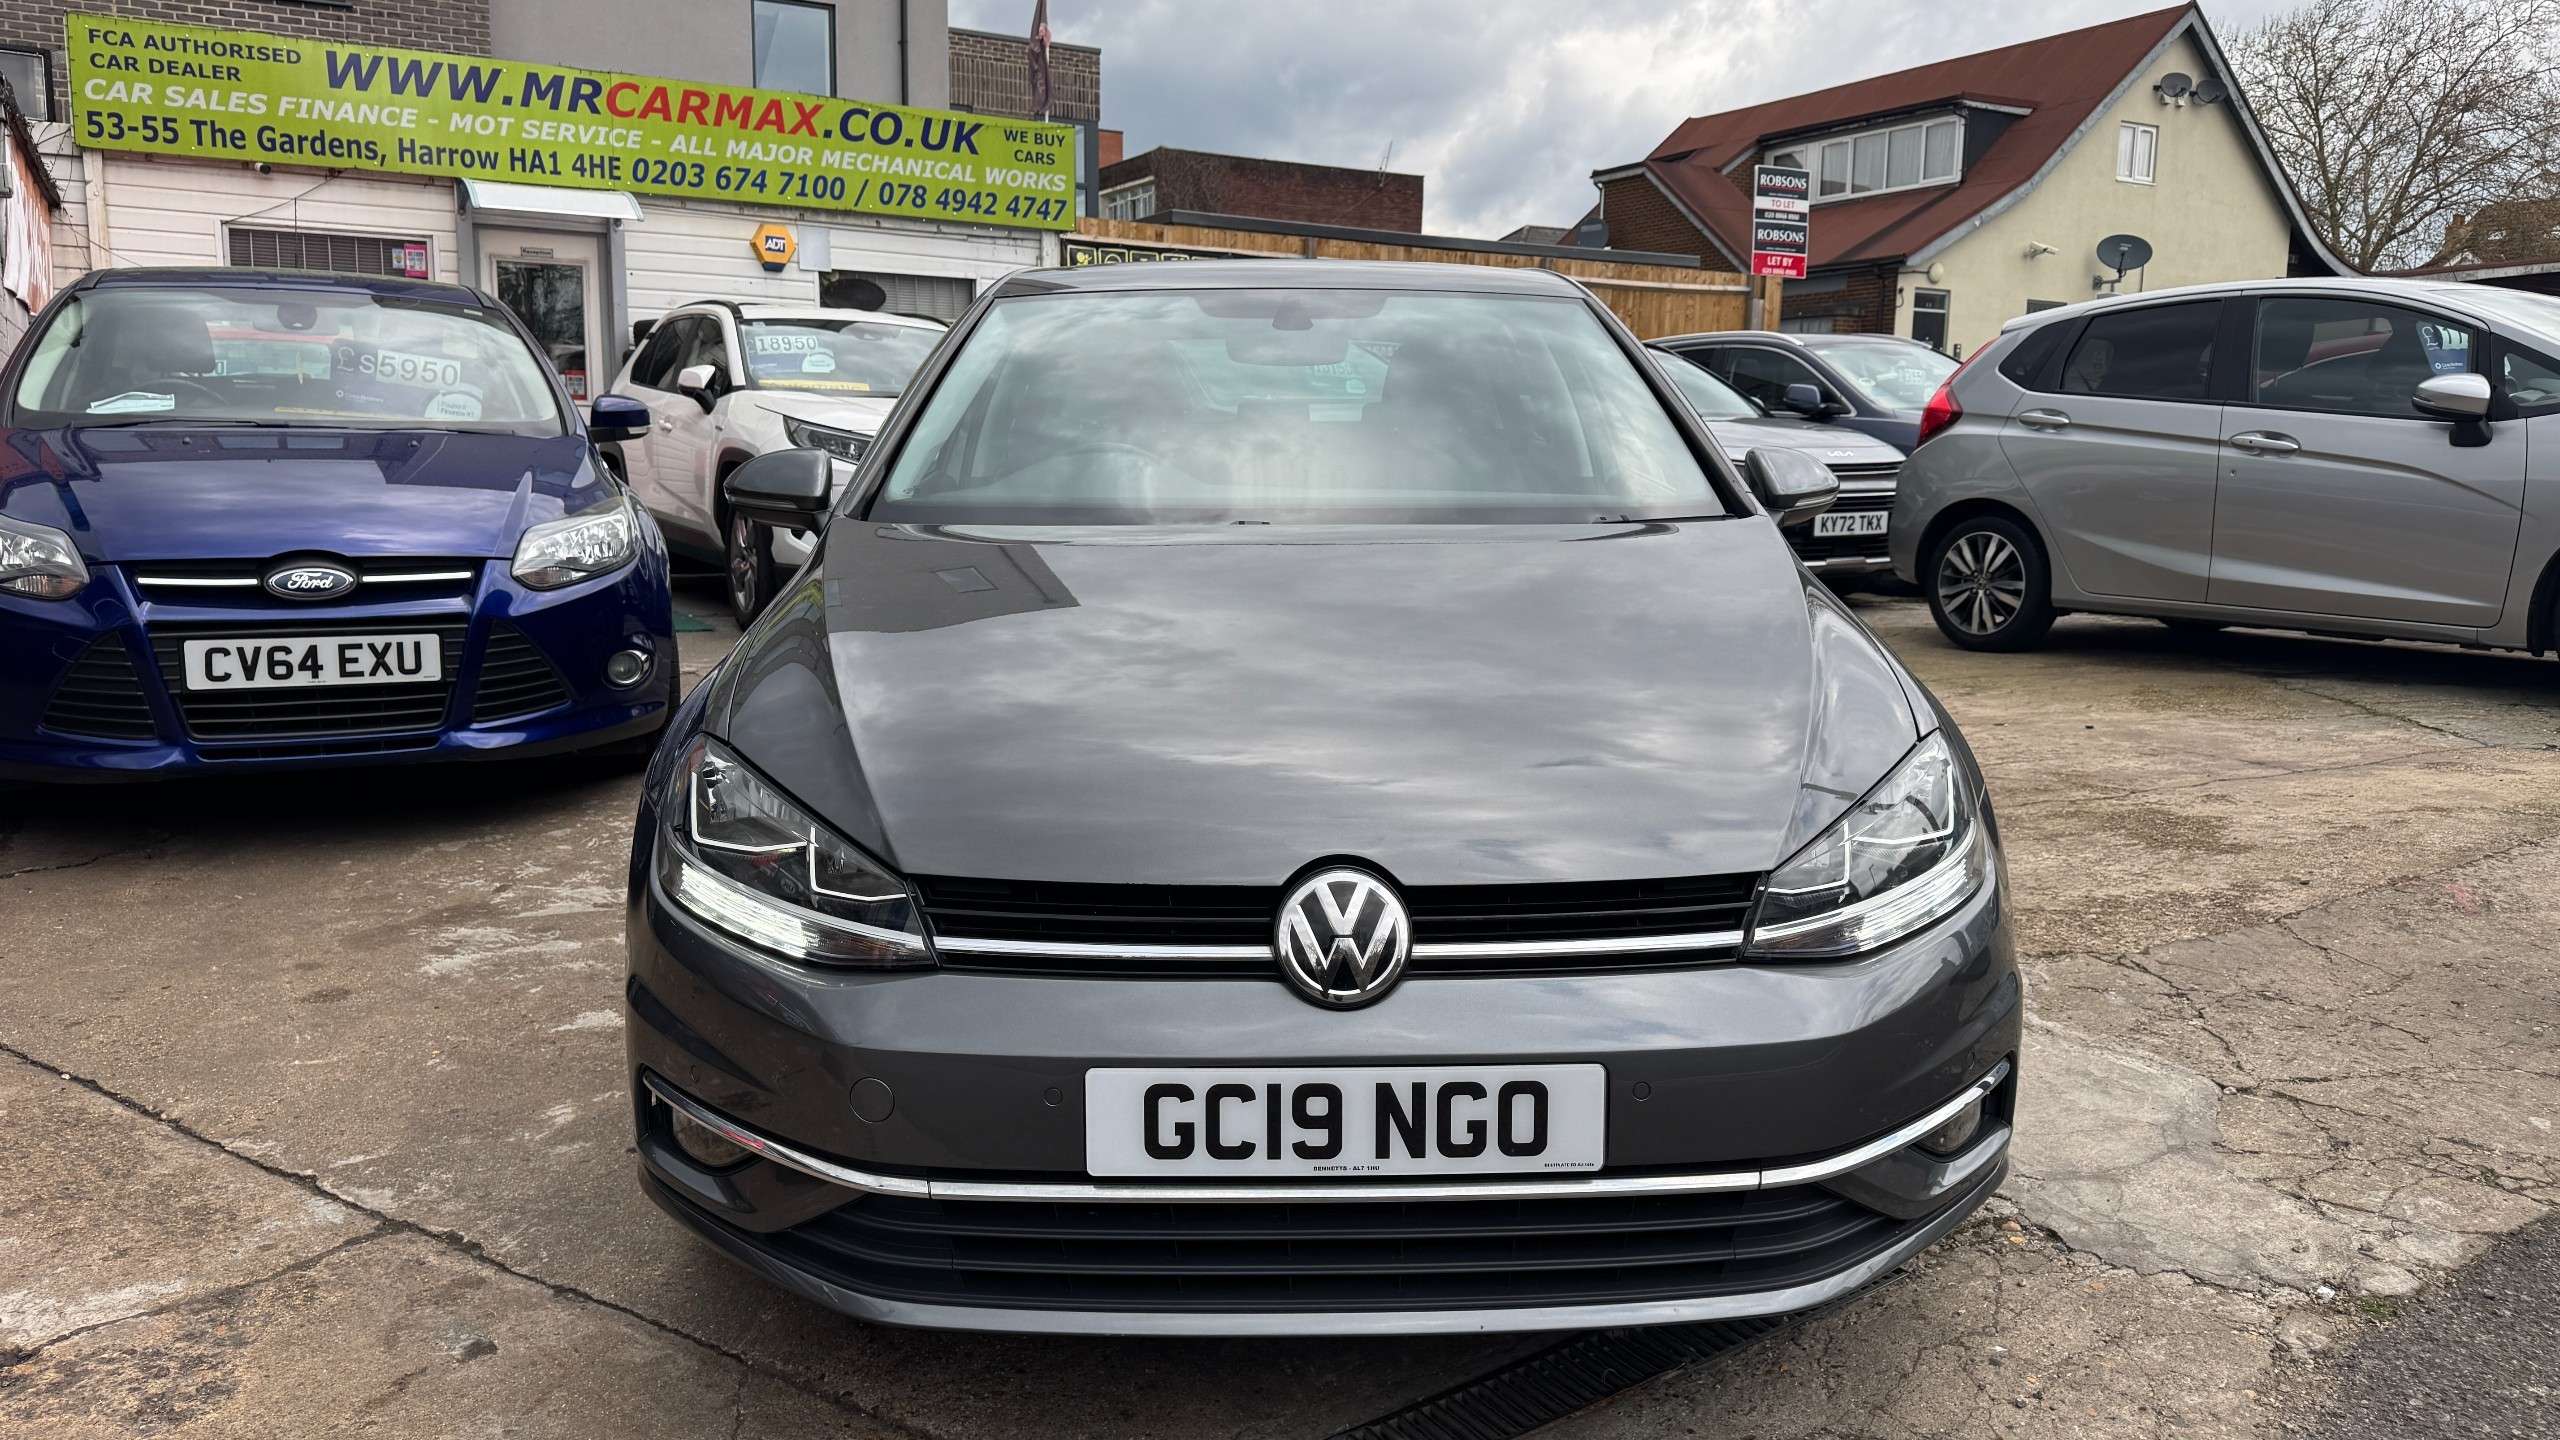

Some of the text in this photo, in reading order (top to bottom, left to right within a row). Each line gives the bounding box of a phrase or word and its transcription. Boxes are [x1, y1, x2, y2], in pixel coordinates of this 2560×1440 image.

[87, 28, 302, 65] FCA AUTHORISED
[89, 52, 243, 82] CAR DEALER
[324, 50, 985, 156] WWW.MRCARMAX.CO.UK
[84, 79, 154, 105] CAR
[164, 85, 267, 116] SALES
[277, 97, 418, 129] FINANCE
[448, 111, 515, 137] MOT
[521, 117, 643, 149] SERVICE
[669, 133, 717, 157] ALL
[725, 139, 814, 166] MAJOR
[820, 149, 977, 183] MECHANICAL
[984, 166, 1067, 193] WORKS
[1003, 128, 1066, 147] WE BUY
[85, 110, 1069, 224] 53-55 The Gardens, Harrow HA1 4HE 0203 674 7100 / 078 4942 4747
[1013, 149, 1057, 165] CARS
[1760, 174, 1807, 190] ROBSONS
[1771, 199, 1796, 209] TO LET
[765, 237, 785, 251] ADT
[1757, 228, 1805, 243] ROBSONS
[1767, 255, 1794, 267] LET BY
[1820, 513, 1883, 534] KY72 TKX
[287, 571, 334, 590] Ford
[203, 640, 422, 682] CV64 EXU
[1143, 1080, 1549, 1161] GC19 NGO
